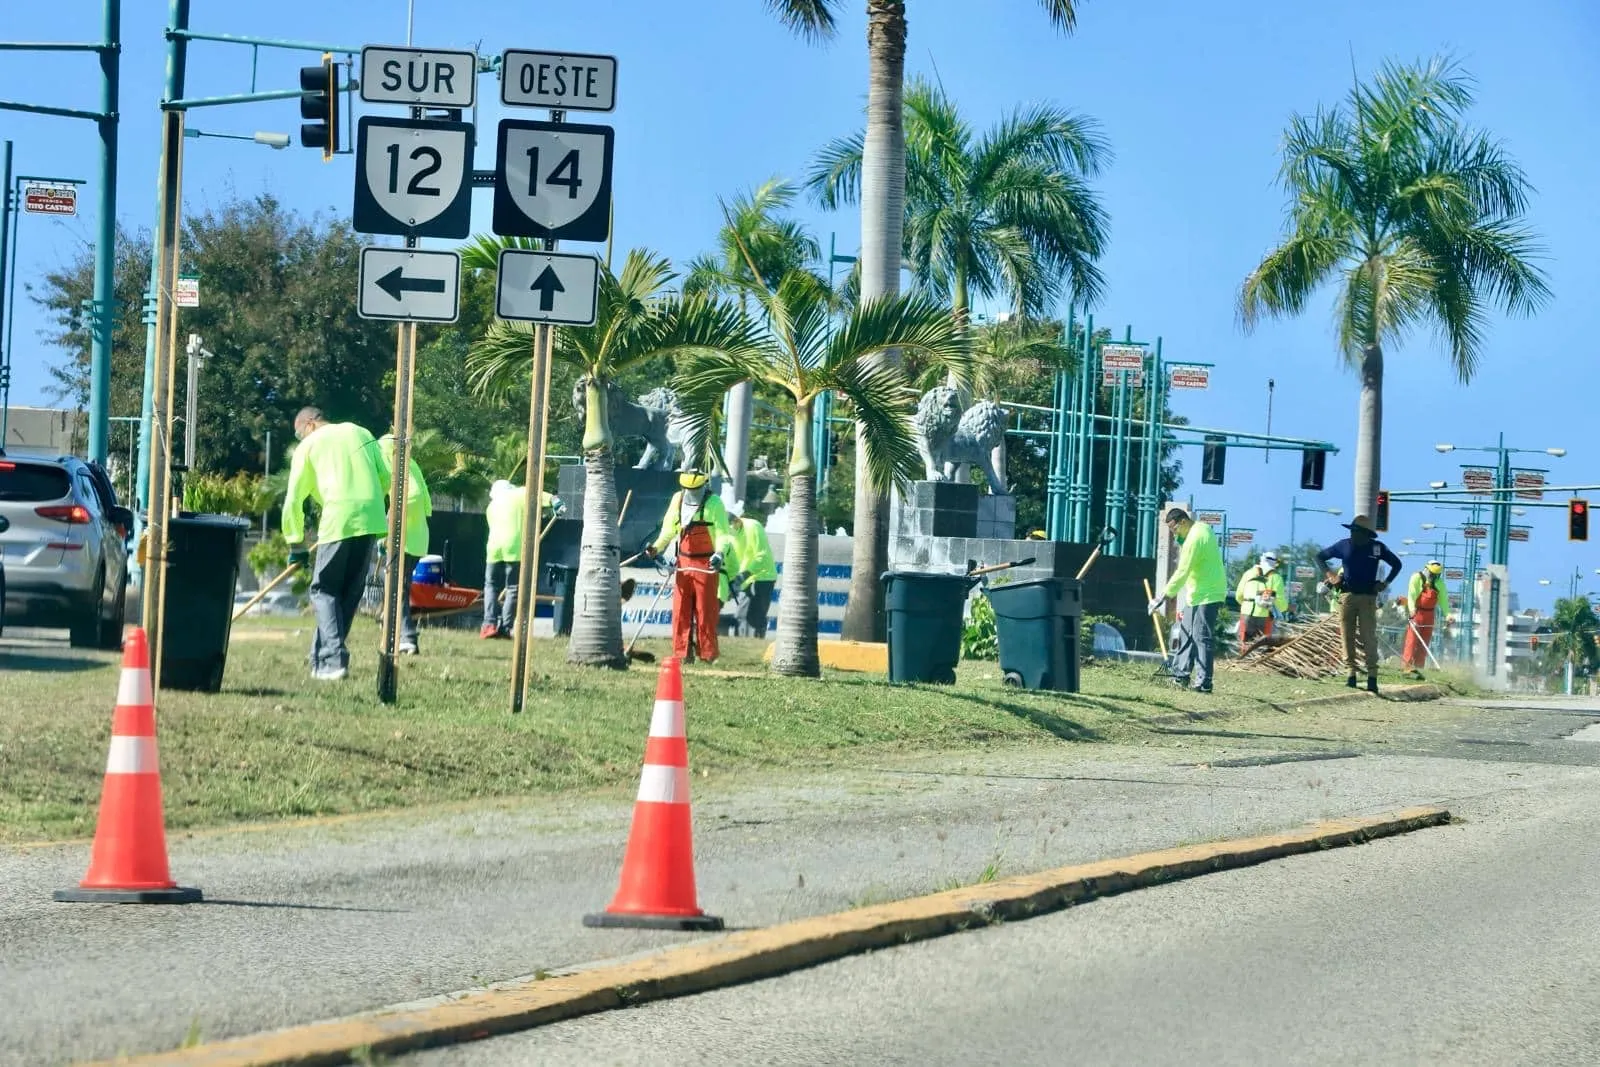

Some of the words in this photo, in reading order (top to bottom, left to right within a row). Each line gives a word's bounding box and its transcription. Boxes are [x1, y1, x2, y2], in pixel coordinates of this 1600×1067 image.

[381, 60, 455, 94] SUR
[520, 63, 599, 98] OESTE
[386, 143, 442, 196] 12
[526, 146, 583, 199] 14
[45, 204, 74, 212] CASTRO
